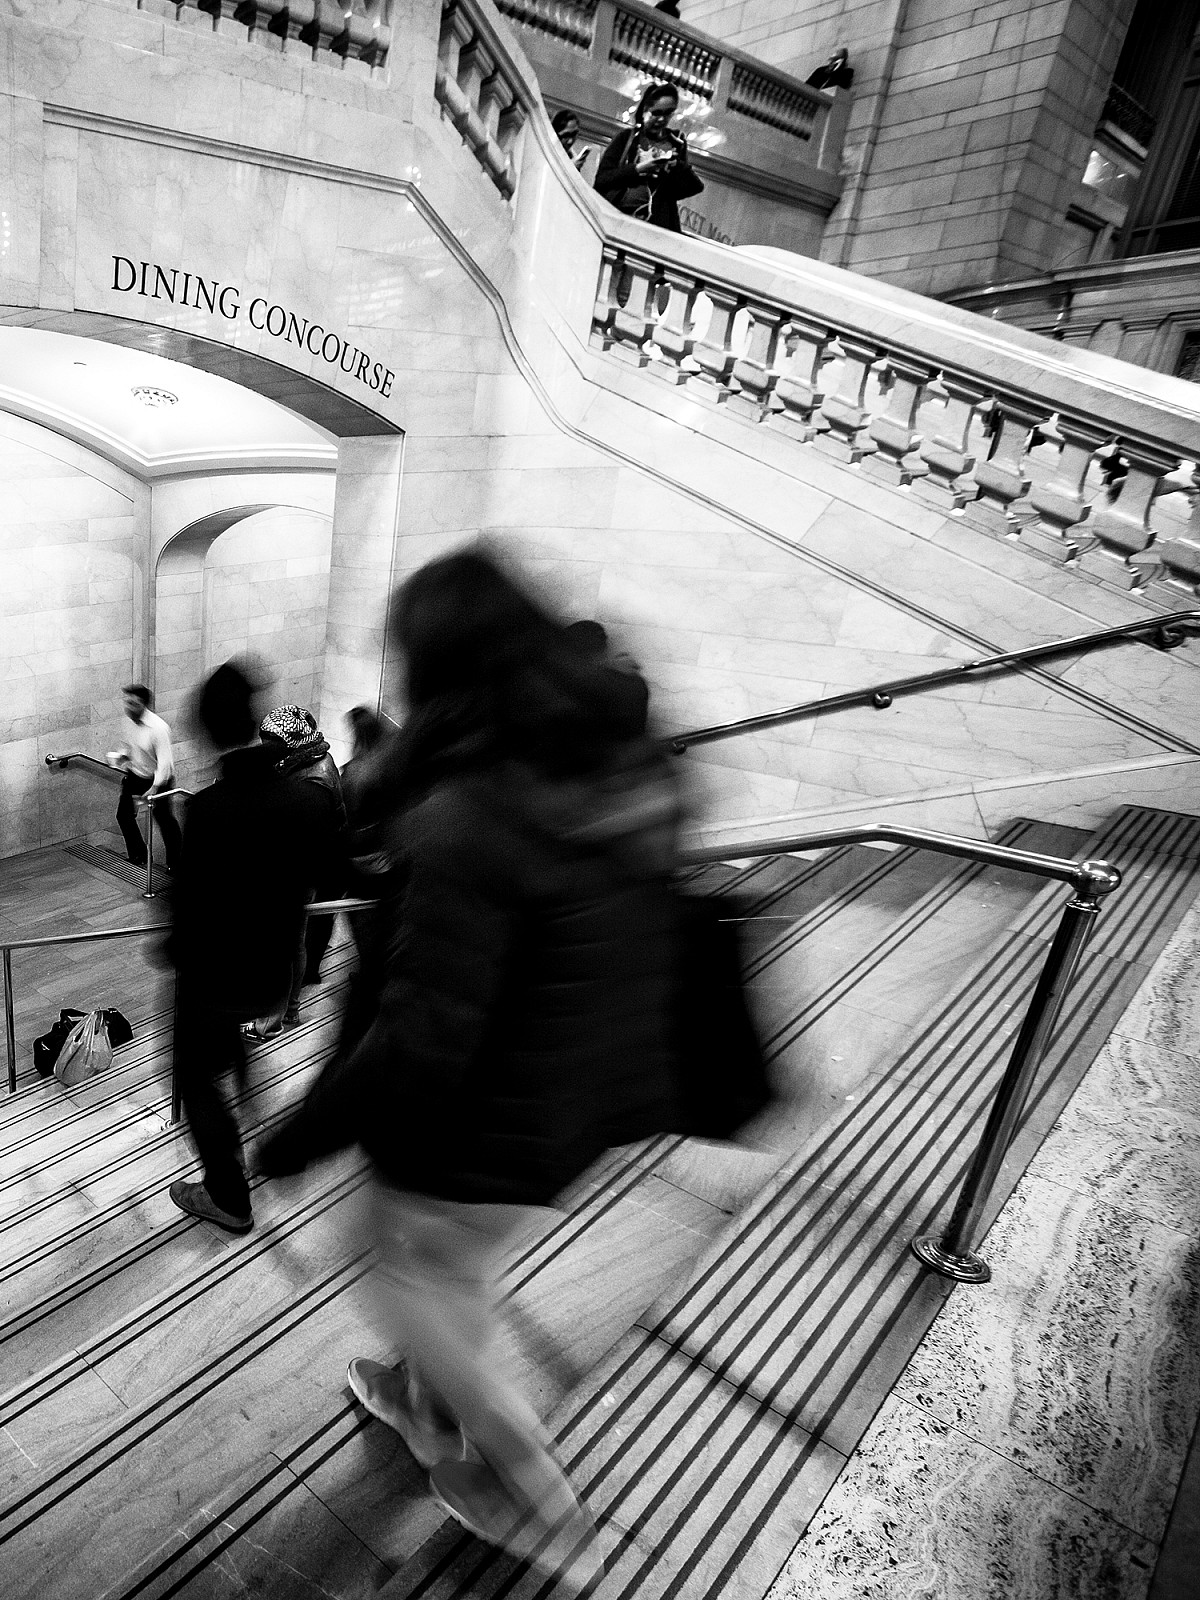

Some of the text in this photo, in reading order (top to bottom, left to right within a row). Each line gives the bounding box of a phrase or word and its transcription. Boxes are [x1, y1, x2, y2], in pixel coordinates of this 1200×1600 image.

[679, 205, 706, 234] CKET
[111, 255, 396, 399] DINING CONCOURSE
